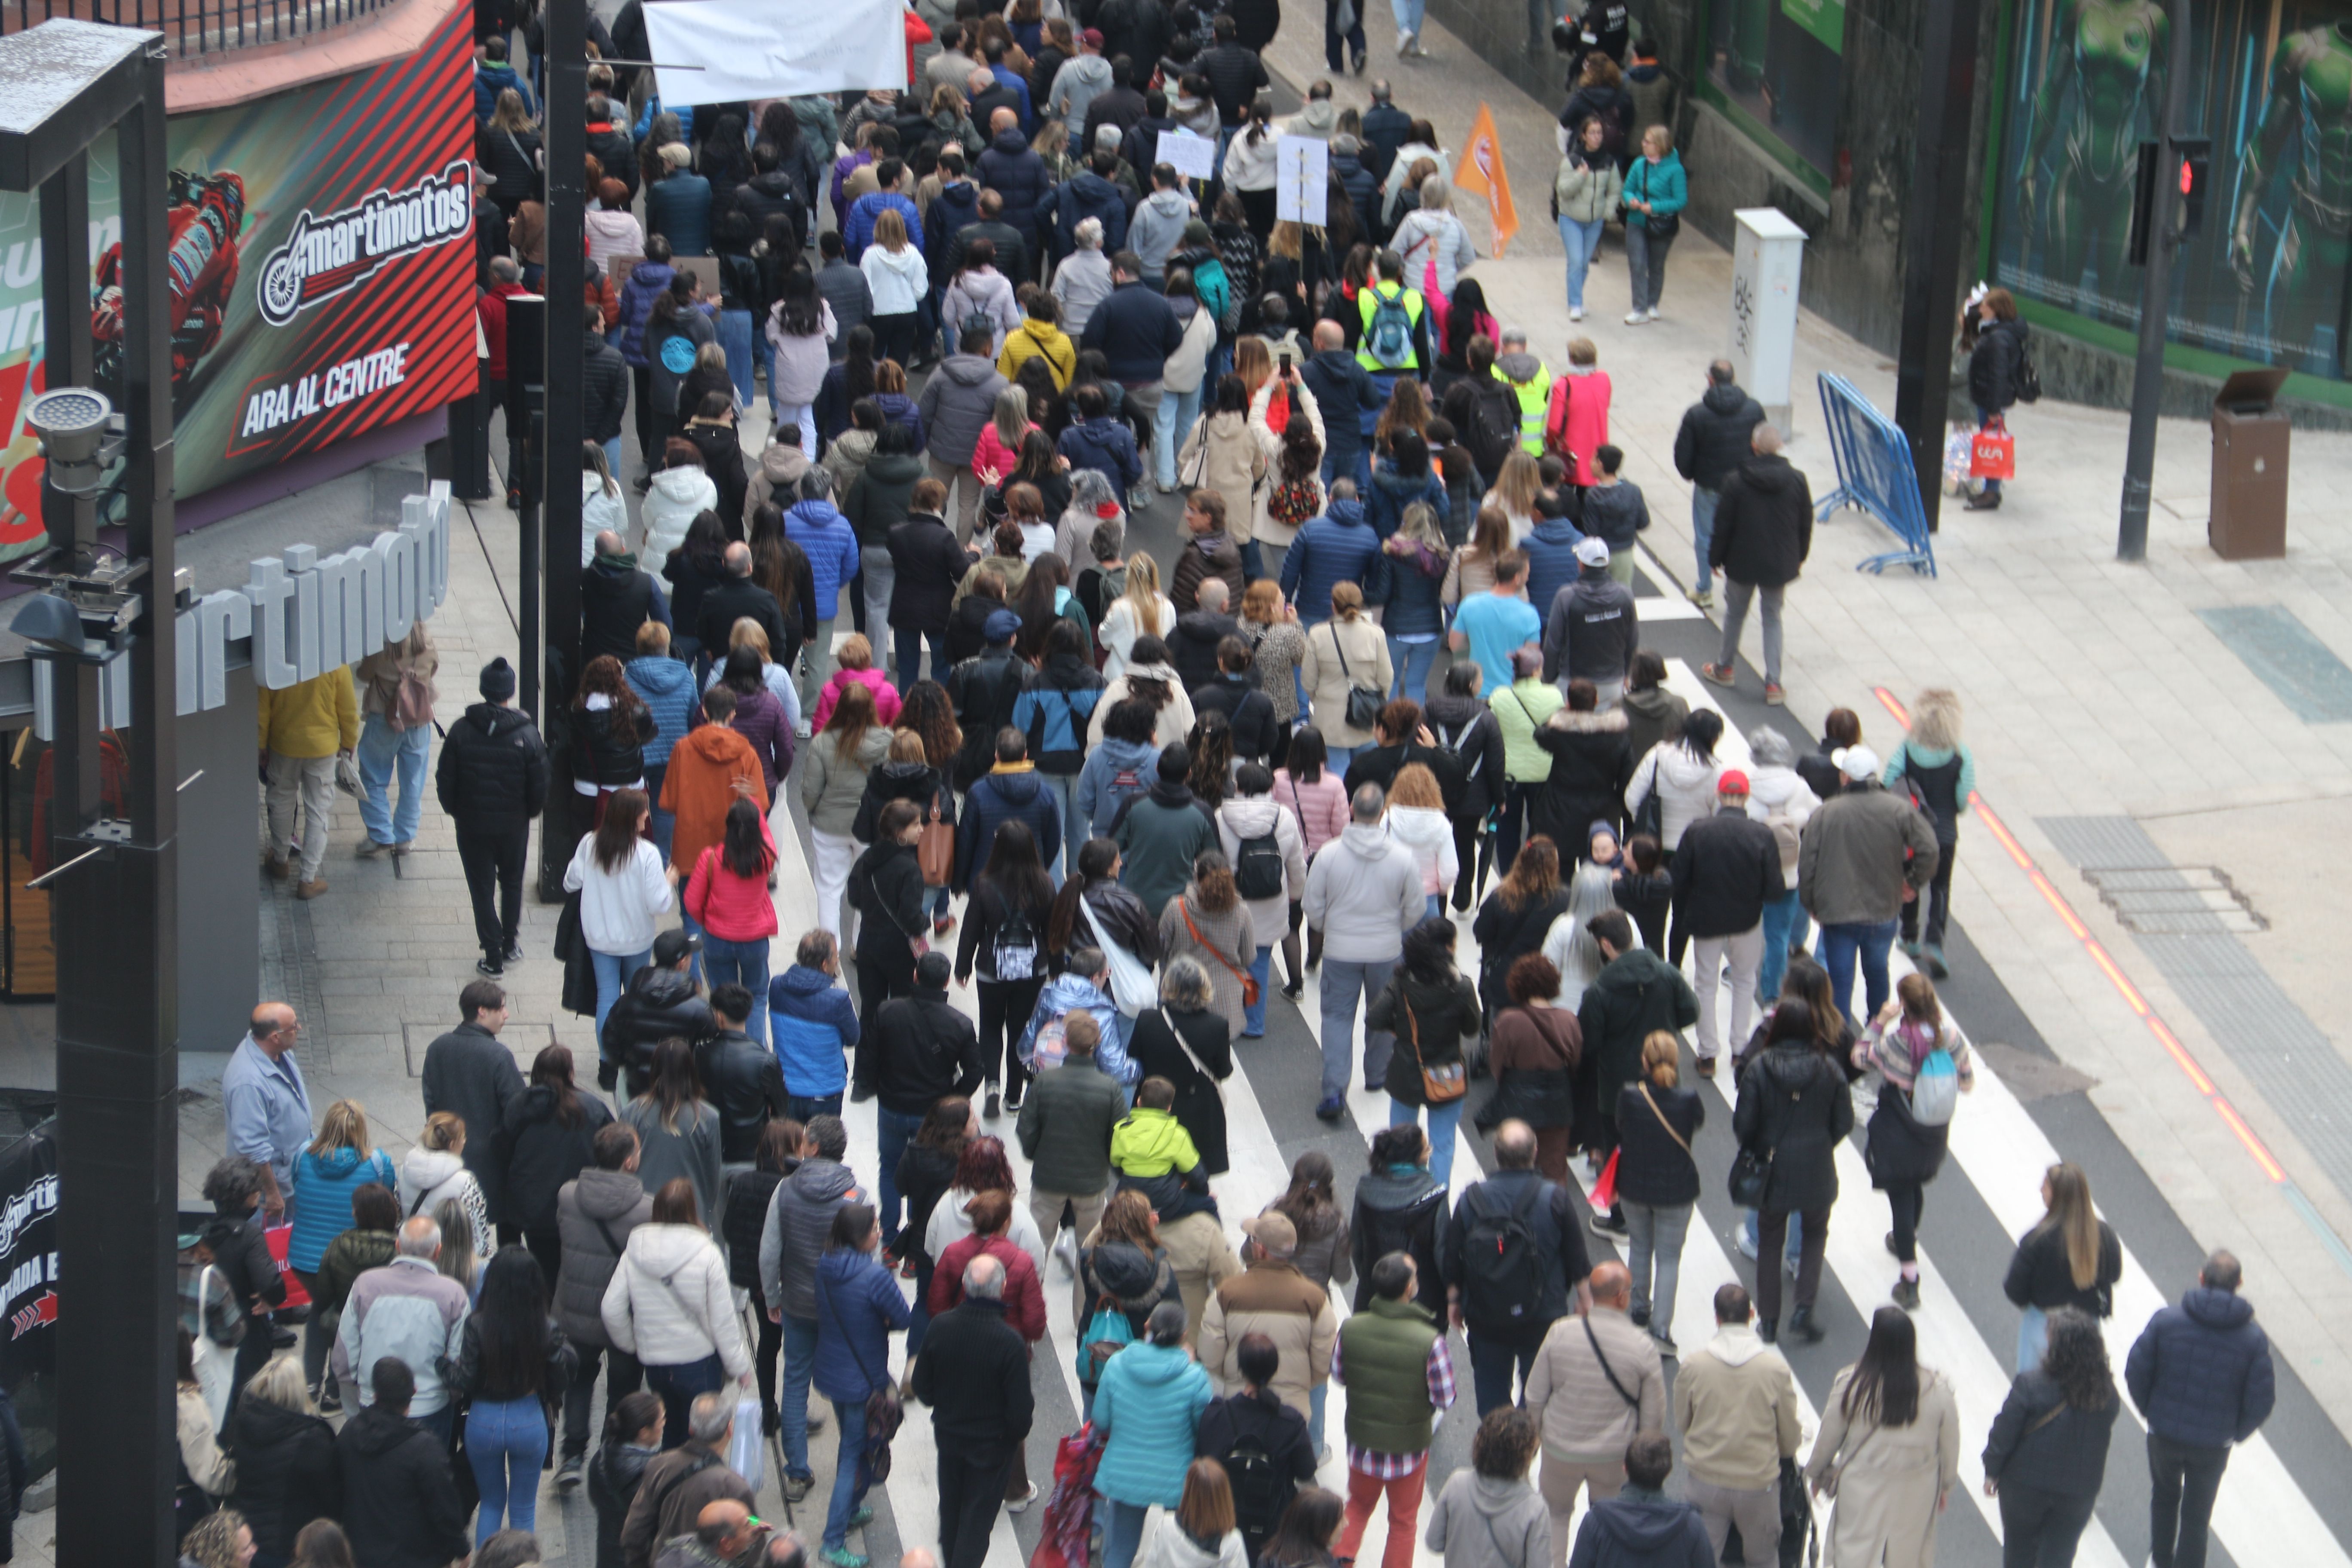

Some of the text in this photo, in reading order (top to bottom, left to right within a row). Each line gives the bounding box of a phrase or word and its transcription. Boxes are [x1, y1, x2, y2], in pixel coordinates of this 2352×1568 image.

[303, 183, 466, 277] martimotos
[242, 341, 410, 438] ARA AL CENTRE
